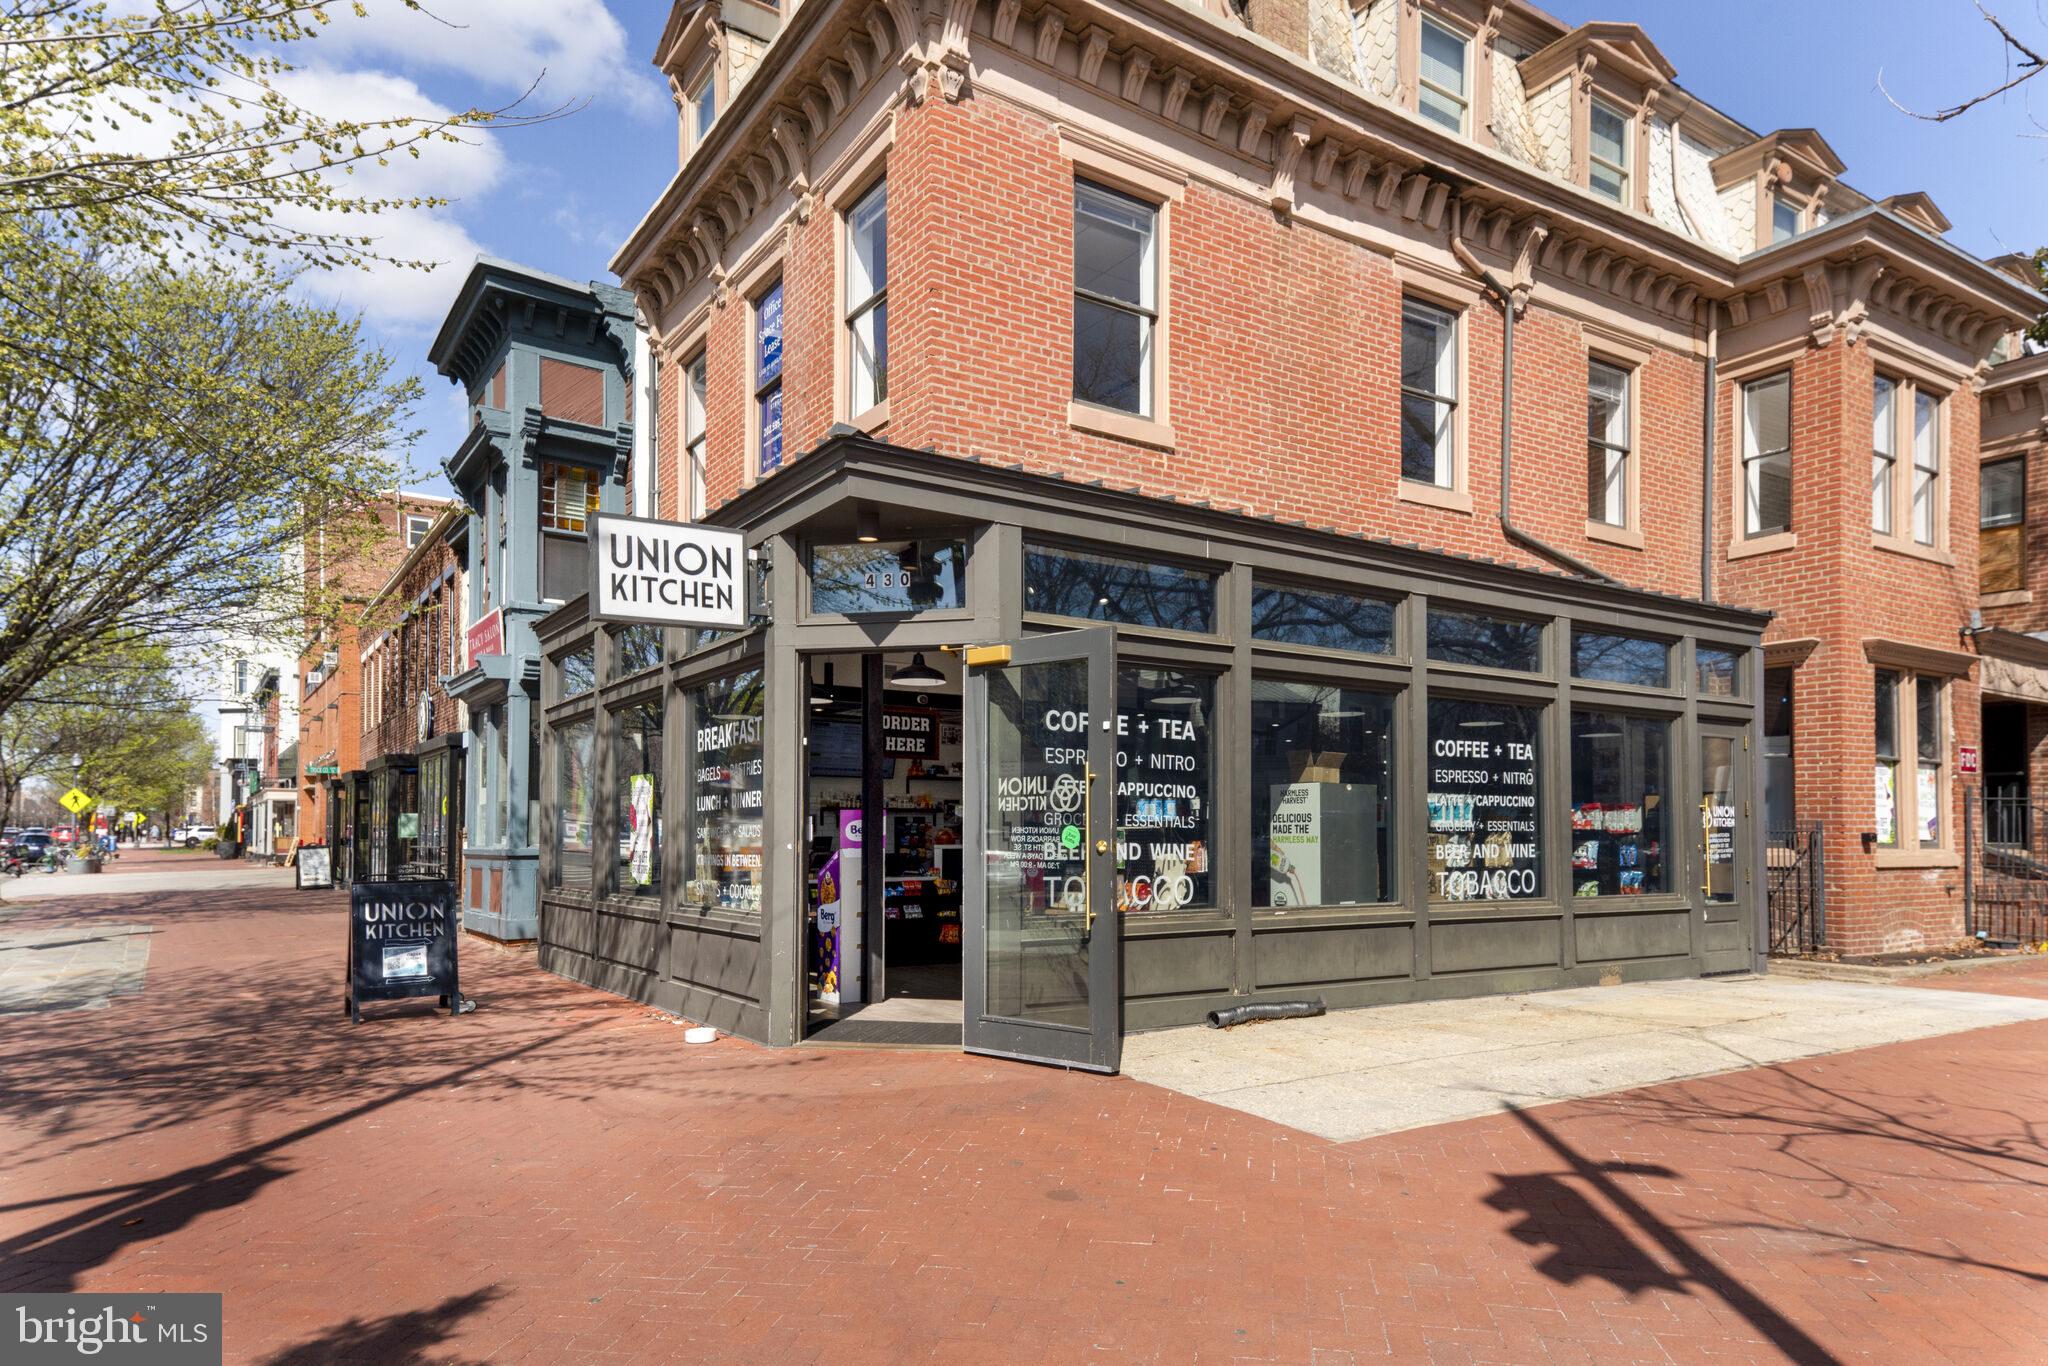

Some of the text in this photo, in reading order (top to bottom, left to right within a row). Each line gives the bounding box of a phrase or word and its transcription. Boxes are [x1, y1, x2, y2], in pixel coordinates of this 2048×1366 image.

[764, 298, 782, 320] Office
[764, 337, 781, 358] Lease
[610, 533, 733, 581] UNION
[866, 573, 910, 587] 430
[611, 573, 733, 611] KITCHEN
[882, 715, 930, 732] ORDER
[1045, 710, 1196, 741] COFE + TEA
[697, 716, 762, 752] BREAKFAST
[886, 736, 926, 752] HERE
[1435, 740, 1534, 760] COFFEE + TEA
[1045, 747, 1195, 772] ESPRO + NITRO
[697, 759, 762, 782] BAGELS PASTRIES
[1435, 769, 1534, 785] ESPRESSO + NITRO
[1117, 783, 1196, 799] APPUCCINO
[1281, 789, 1309, 797] HARMLESS
[696, 794, 721, 811] LUNCH
[731, 790, 762, 808] DINNER
[1282, 797, 1307, 805] HARVEST
[1476, 795, 1535, 807] CAPPUCCINO
[1272, 813, 1312, 823] DELICIOUS
[1713, 806, 1735, 817] UNION
[1044, 813, 1195, 829] GROC ESSENTIALS
[1272, 824, 1309, 834] MADE THE
[1487, 820, 1535, 832] ESSENTIALS
[738, 824, 761, 838] SALADS
[1273, 836, 1319, 844] HARMLESS WAY
[1117, 842, 1141, 860] ND
[1150, 844, 1195, 861] WINE
[1436, 843, 1536, 859] BEER AND WINE
[725, 854, 731, 866] IN
[1043, 875, 1194, 906] TOCCO
[1435, 869, 1536, 896] TOBACCO
[730, 883, 762, 900] COOKIES
[364, 902, 445, 921] UNION
[821, 908, 835, 924] Berg
[365, 922, 445, 939] KITCHEN
